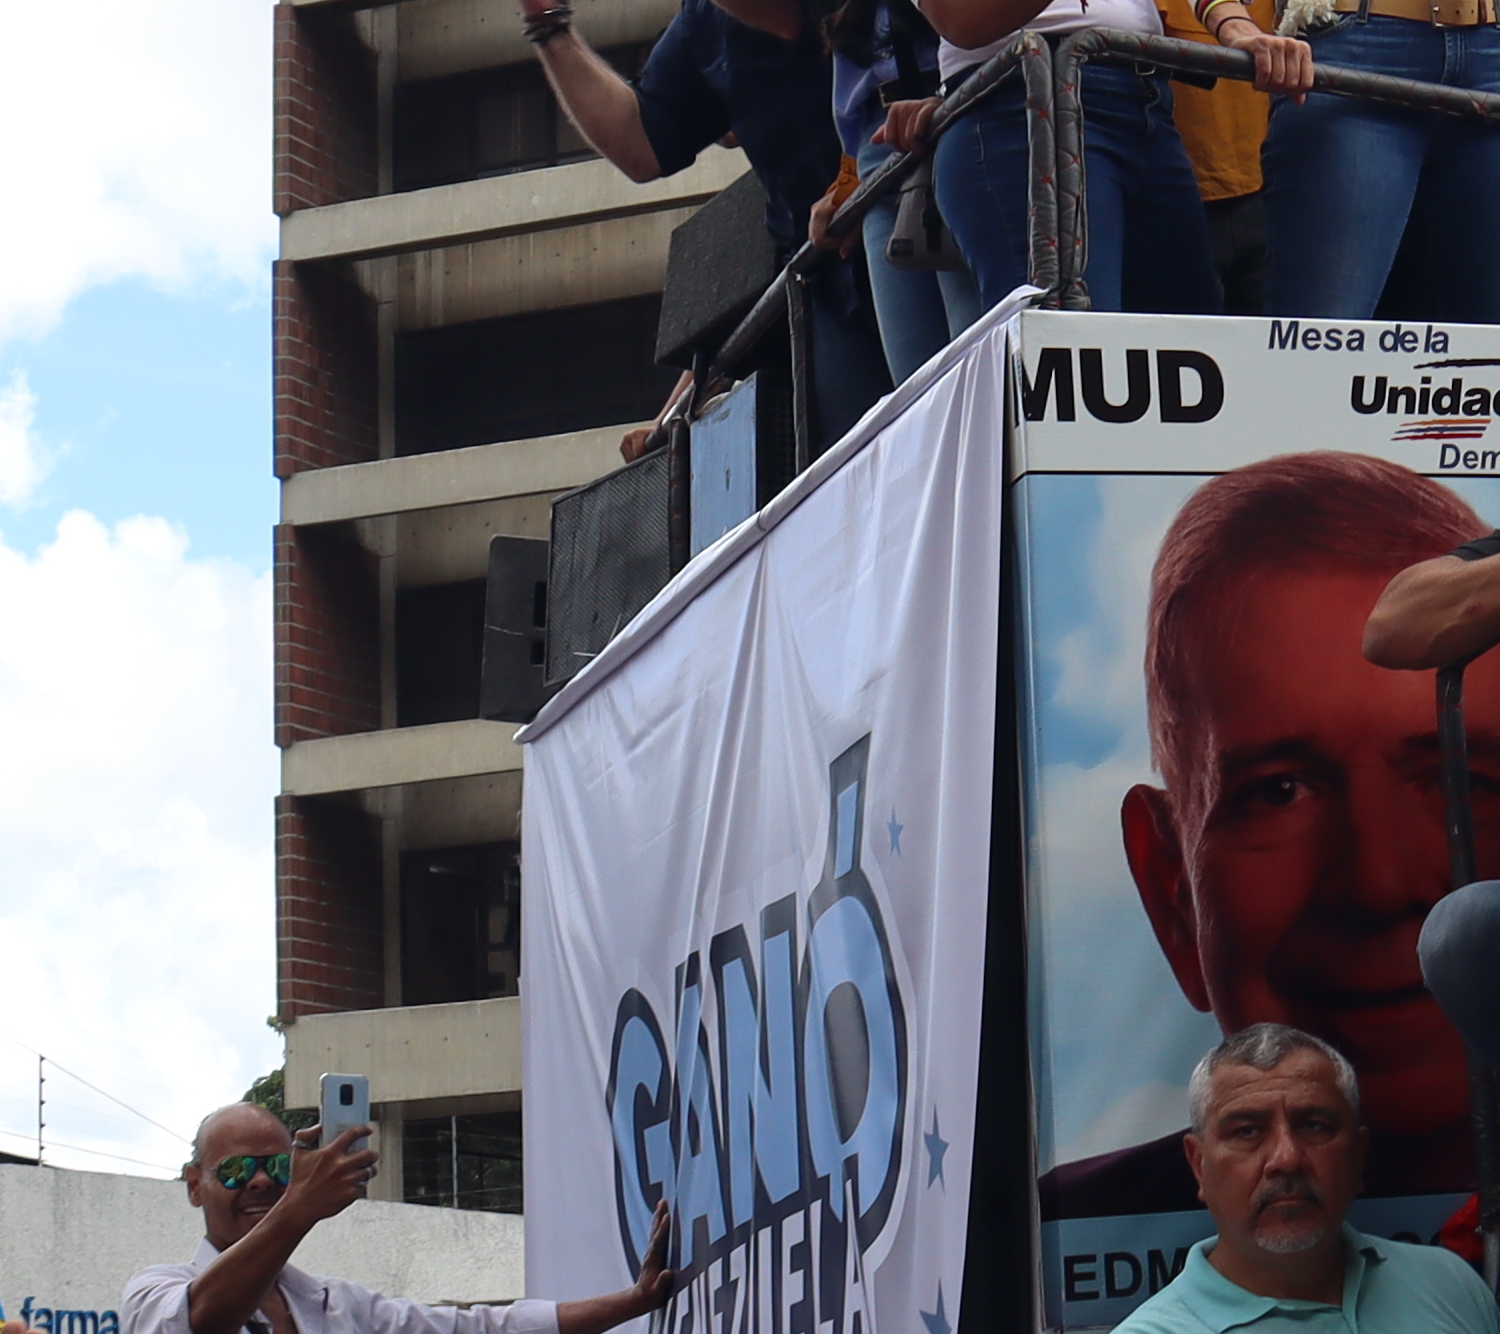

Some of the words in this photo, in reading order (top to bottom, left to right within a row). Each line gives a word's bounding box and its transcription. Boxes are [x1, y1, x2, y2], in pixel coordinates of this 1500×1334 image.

[1268, 320, 1364, 352] Mesa
[1379, 323, 1419, 354] de
[1424, 324, 1449, 354] la
[1015, 347, 1225, 425] MUD
[606, 734, 907, 1274] GANÓ
